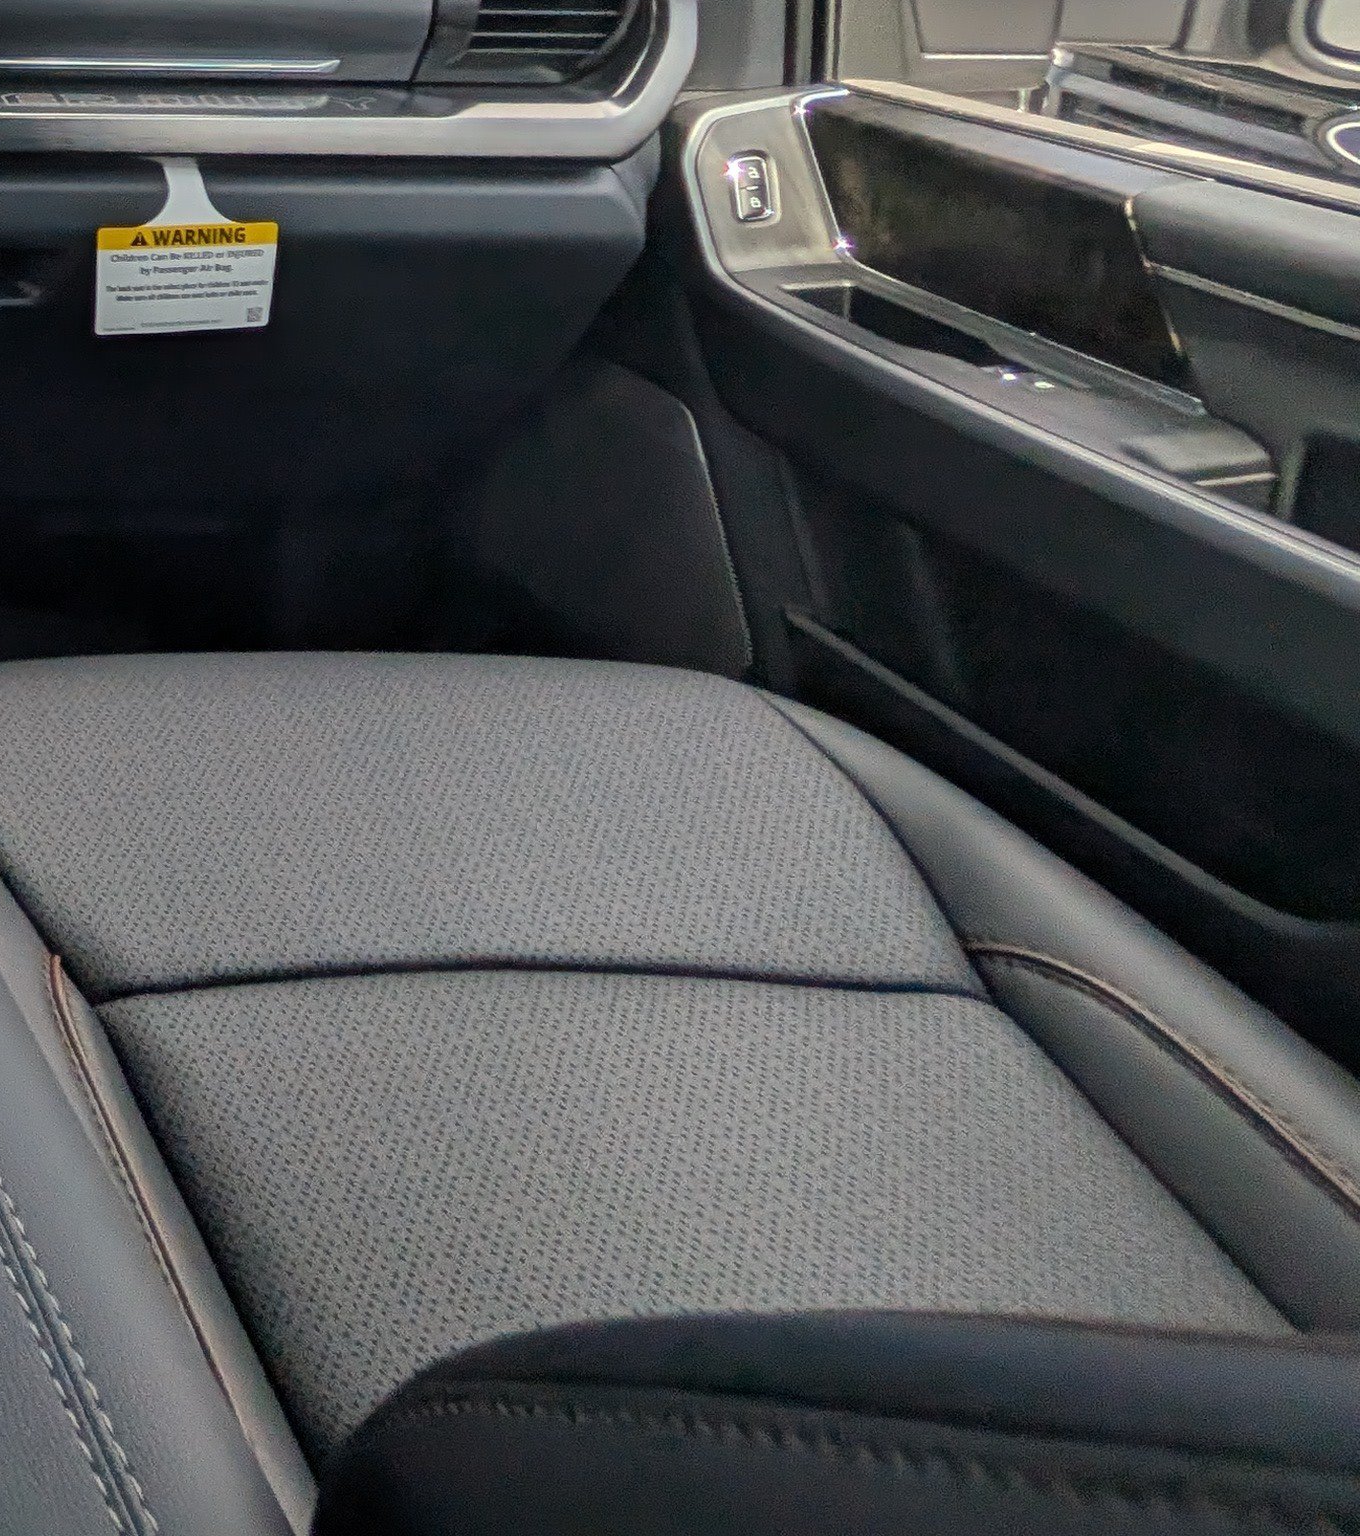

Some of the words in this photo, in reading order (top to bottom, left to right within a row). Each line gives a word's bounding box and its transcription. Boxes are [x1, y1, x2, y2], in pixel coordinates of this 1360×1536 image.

[152, 226, 246, 247] WARNING
[111, 251, 149, 263] Children
[150, 252, 168, 262] Can
[183, 250, 214, 260] KILLED
[227, 249, 265, 260] INJURED
[140, 266, 152, 276] by
[153, 265, 199, 275] Passenger
